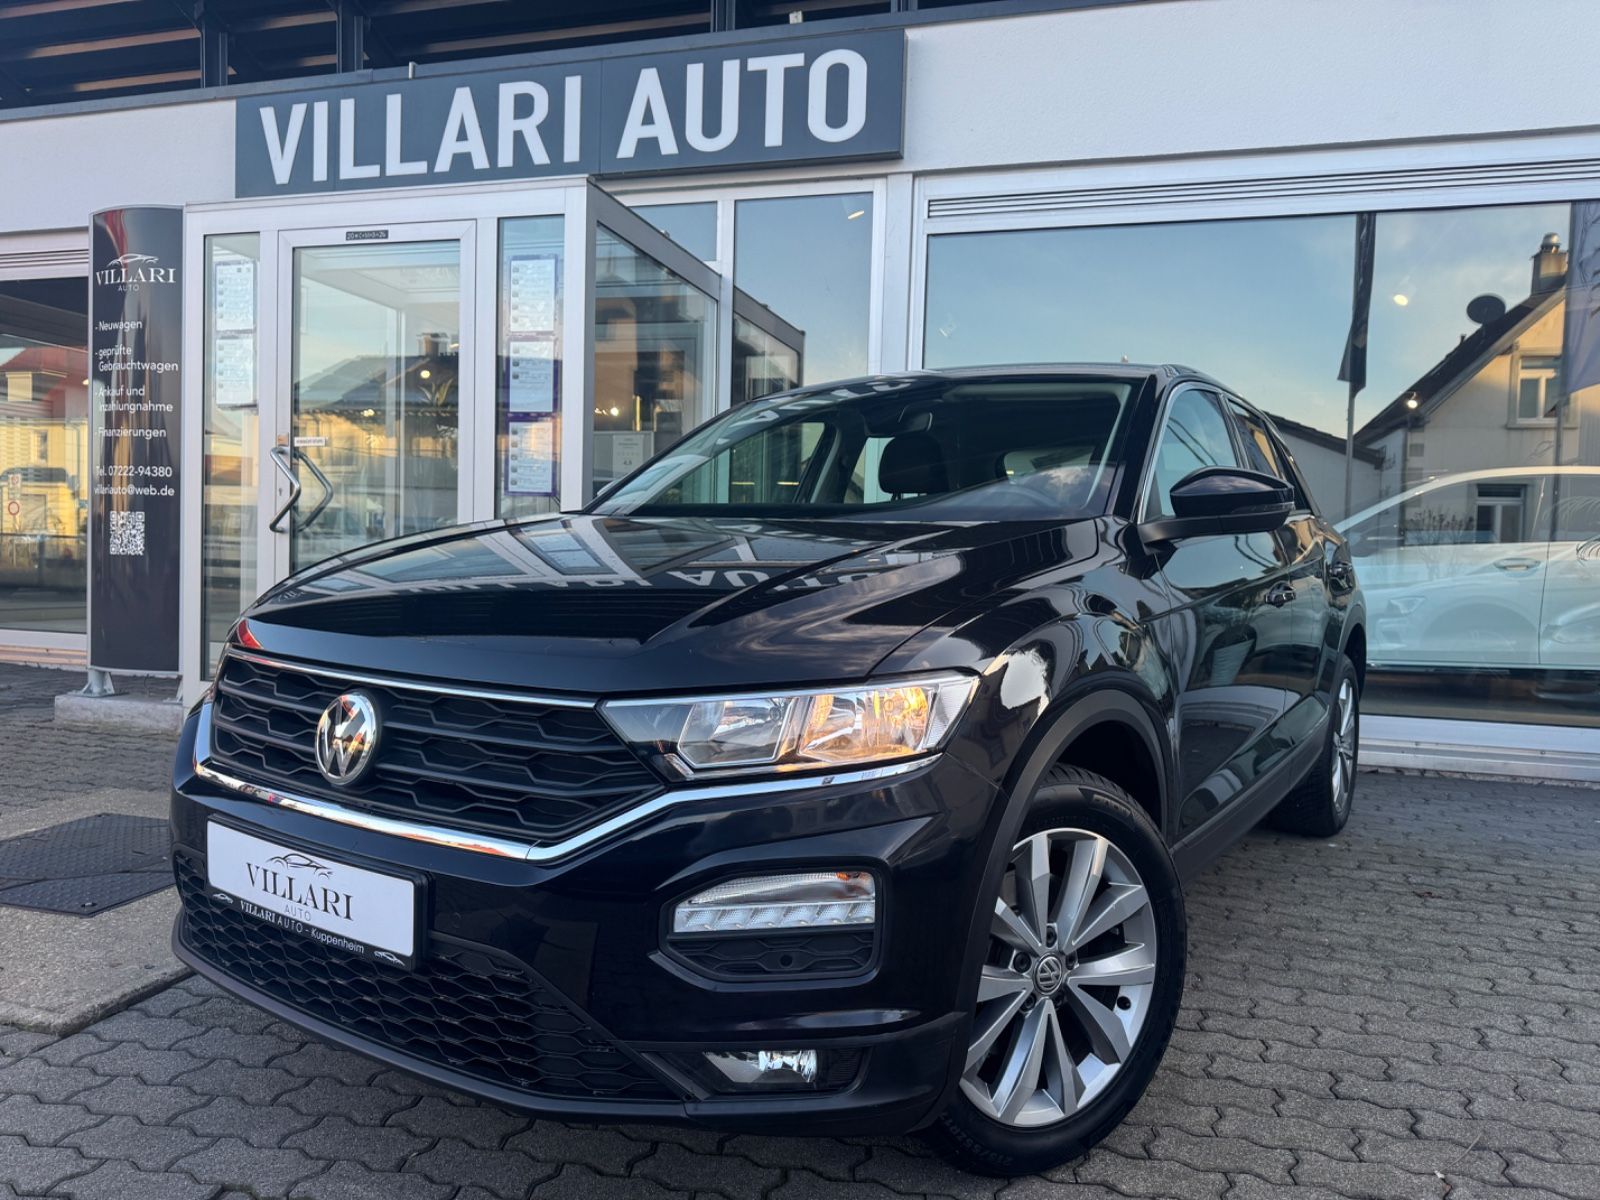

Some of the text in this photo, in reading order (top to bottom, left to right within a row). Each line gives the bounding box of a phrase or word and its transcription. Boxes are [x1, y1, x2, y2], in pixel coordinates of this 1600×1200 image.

[260, 48, 868, 186] VILLARI AUTO
[95, 267, 176, 286] VILLARI
[118, 284, 140, 292] AUTO
[99, 320, 143, 332] Neuwagen
[98, 344, 132, 359] geprüfte
[98, 360, 179, 373] Gebrauchtwagen
[98, 384, 146, 397] Ankauf und
[98, 426, 167, 440] Finanzierungen
[95, 465, 173, 478] Tel. 07222-94380
[94, 484, 175, 497] villariauto@web.de
[246, 862, 355, 922] VILLARI
[284, 903, 312, 922] AUTO
[240, 900, 276, 924] VILLARI
[277, 914, 303, 934] AUTO
[311, 928, 365, 954] Kuppenheim
